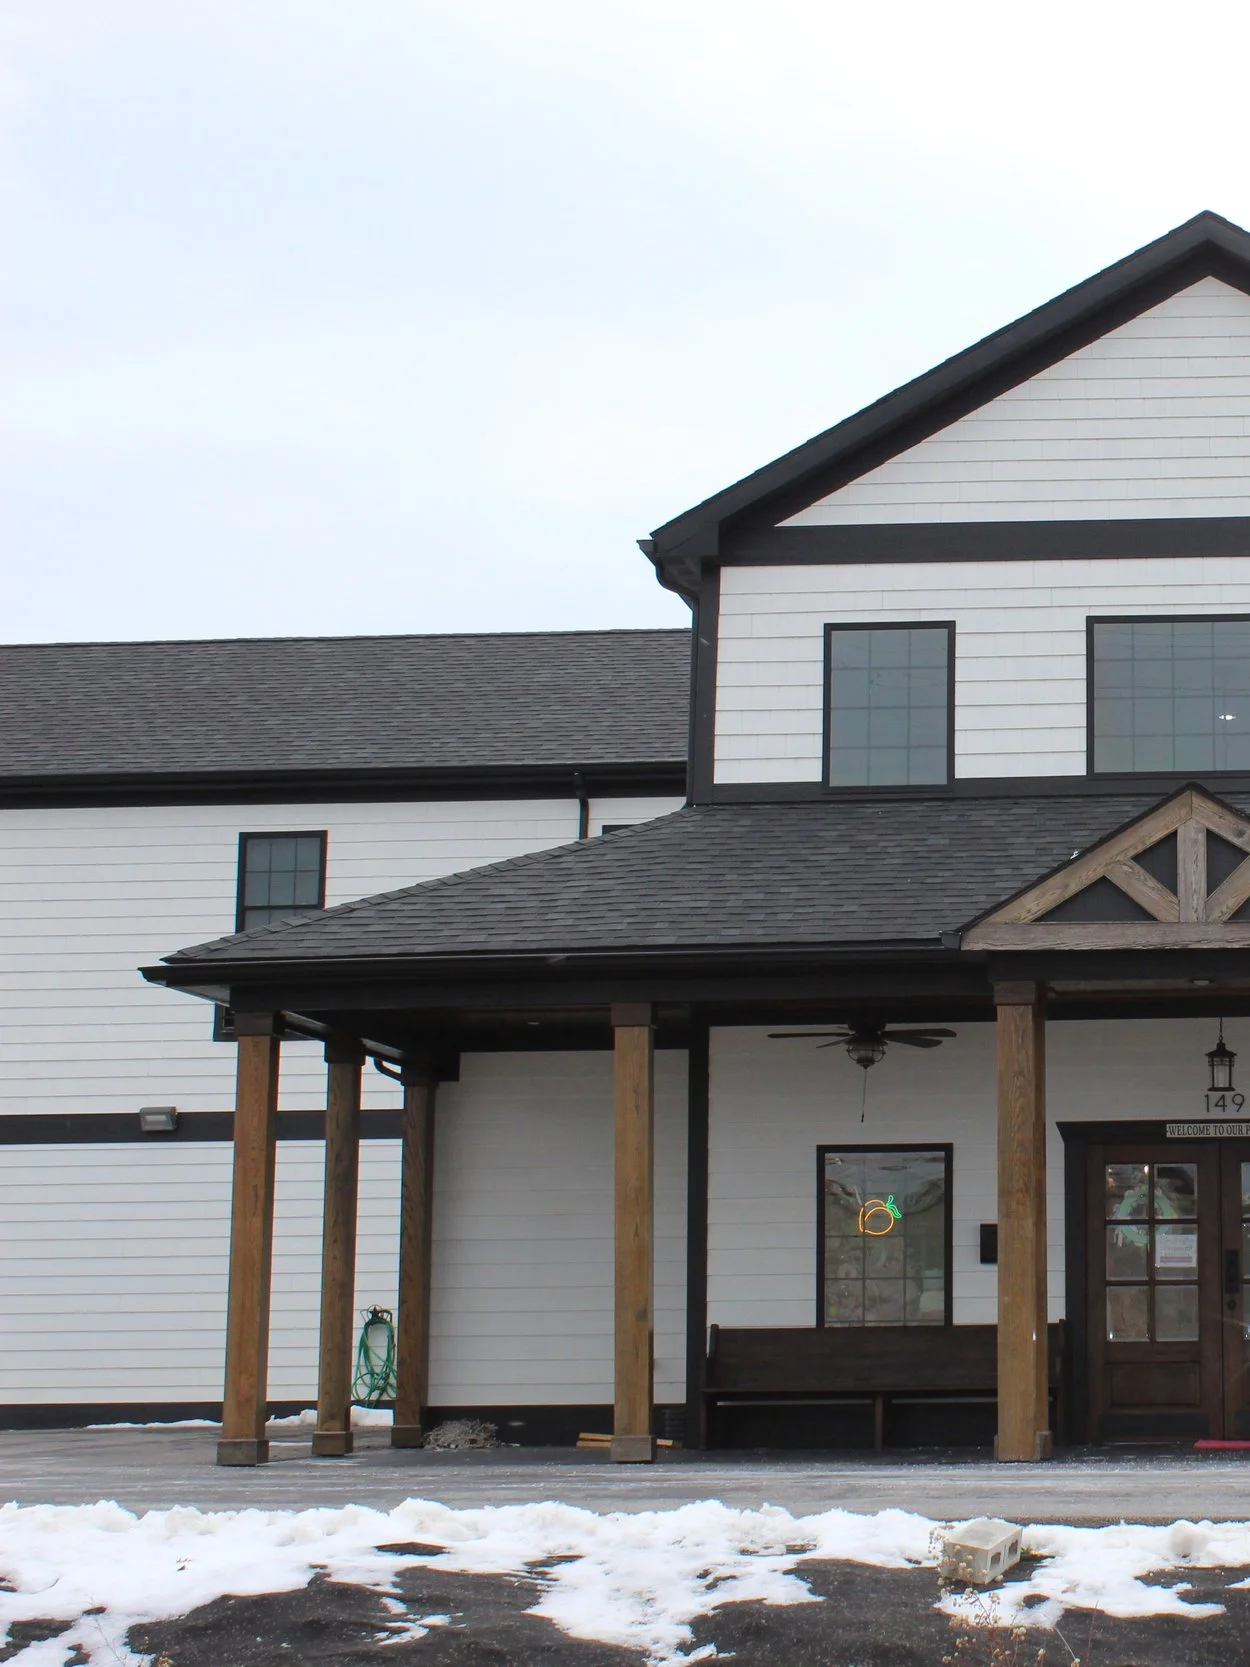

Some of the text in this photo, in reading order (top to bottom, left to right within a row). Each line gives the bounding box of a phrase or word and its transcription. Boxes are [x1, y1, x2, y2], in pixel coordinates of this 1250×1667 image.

[1204, 1093, 1245, 1113] 149
[1168, 1125, 1211, 1136] WELCOME
[1213, 1124, 1224, 1136] TO
[1226, 1124, 1244, 1136] OUR
